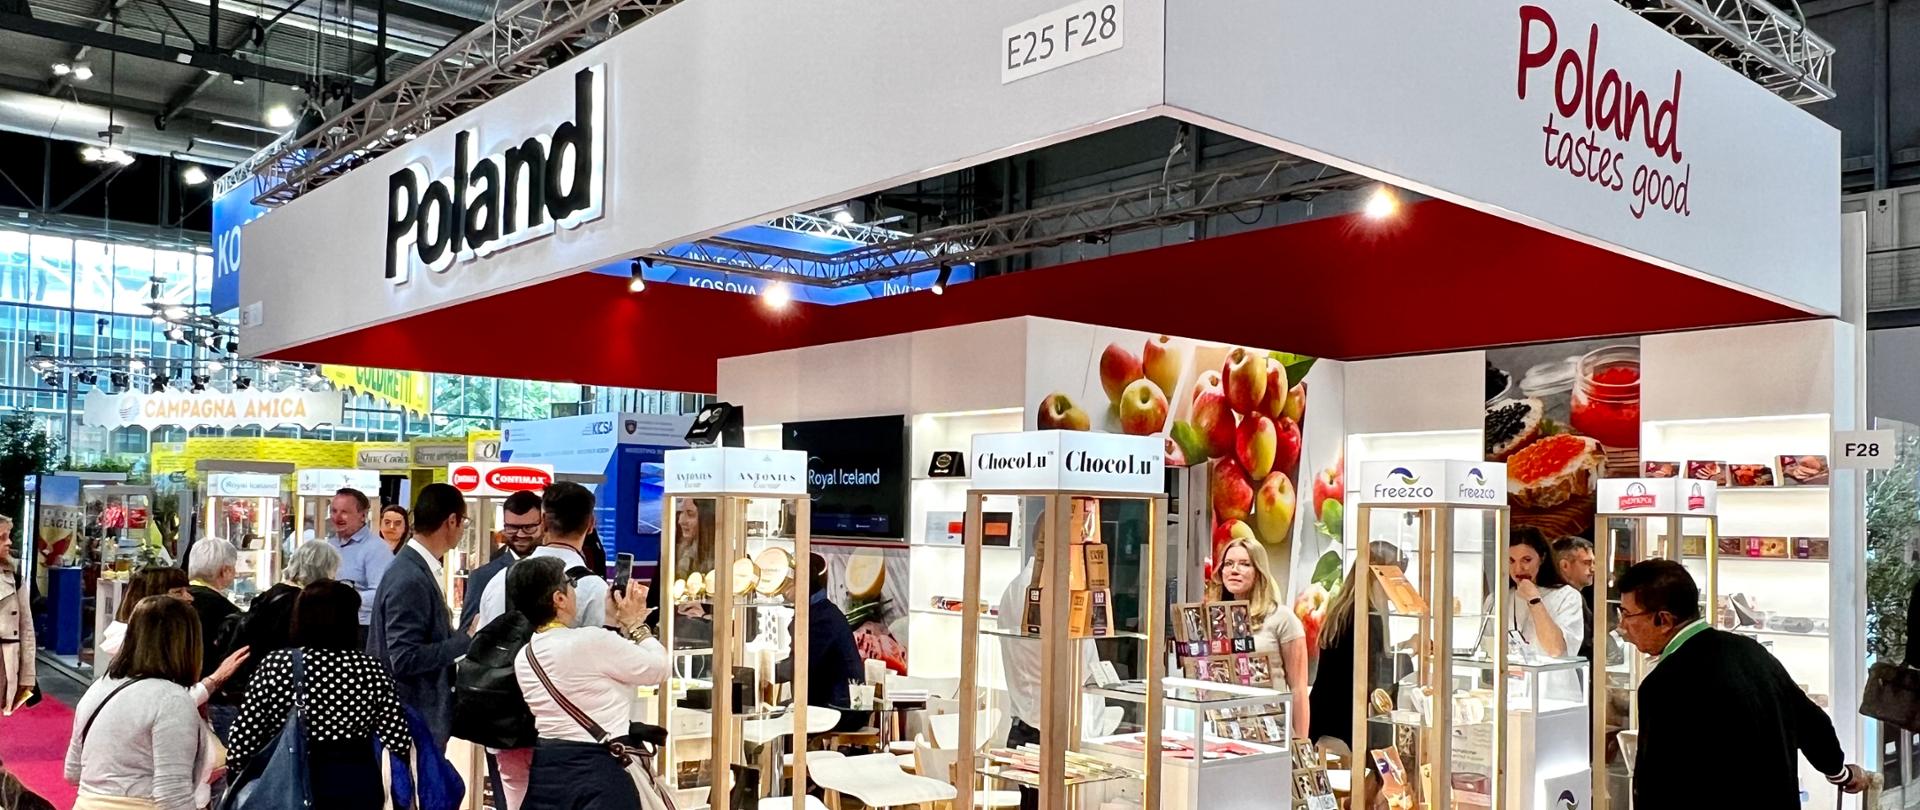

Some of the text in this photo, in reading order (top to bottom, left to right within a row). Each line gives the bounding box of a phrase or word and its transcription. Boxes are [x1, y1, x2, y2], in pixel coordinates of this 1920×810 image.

[1008, 4, 1116, 70] E25 F28
[1518, 5, 1682, 164] Poland
[385, 67, 594, 279] Poland
[1543, 112, 1690, 219] tastes good
[144, 398, 306, 418] CAMPAGNA AMICA
[1845, 443, 1880, 457] F28
[740, 472, 796, 482] ANTONIUS
[808, 467, 881, 490] Royal Iceland
[1374, 484, 1433, 498] Freezco
[1458, 484, 1495, 500] Freezco
